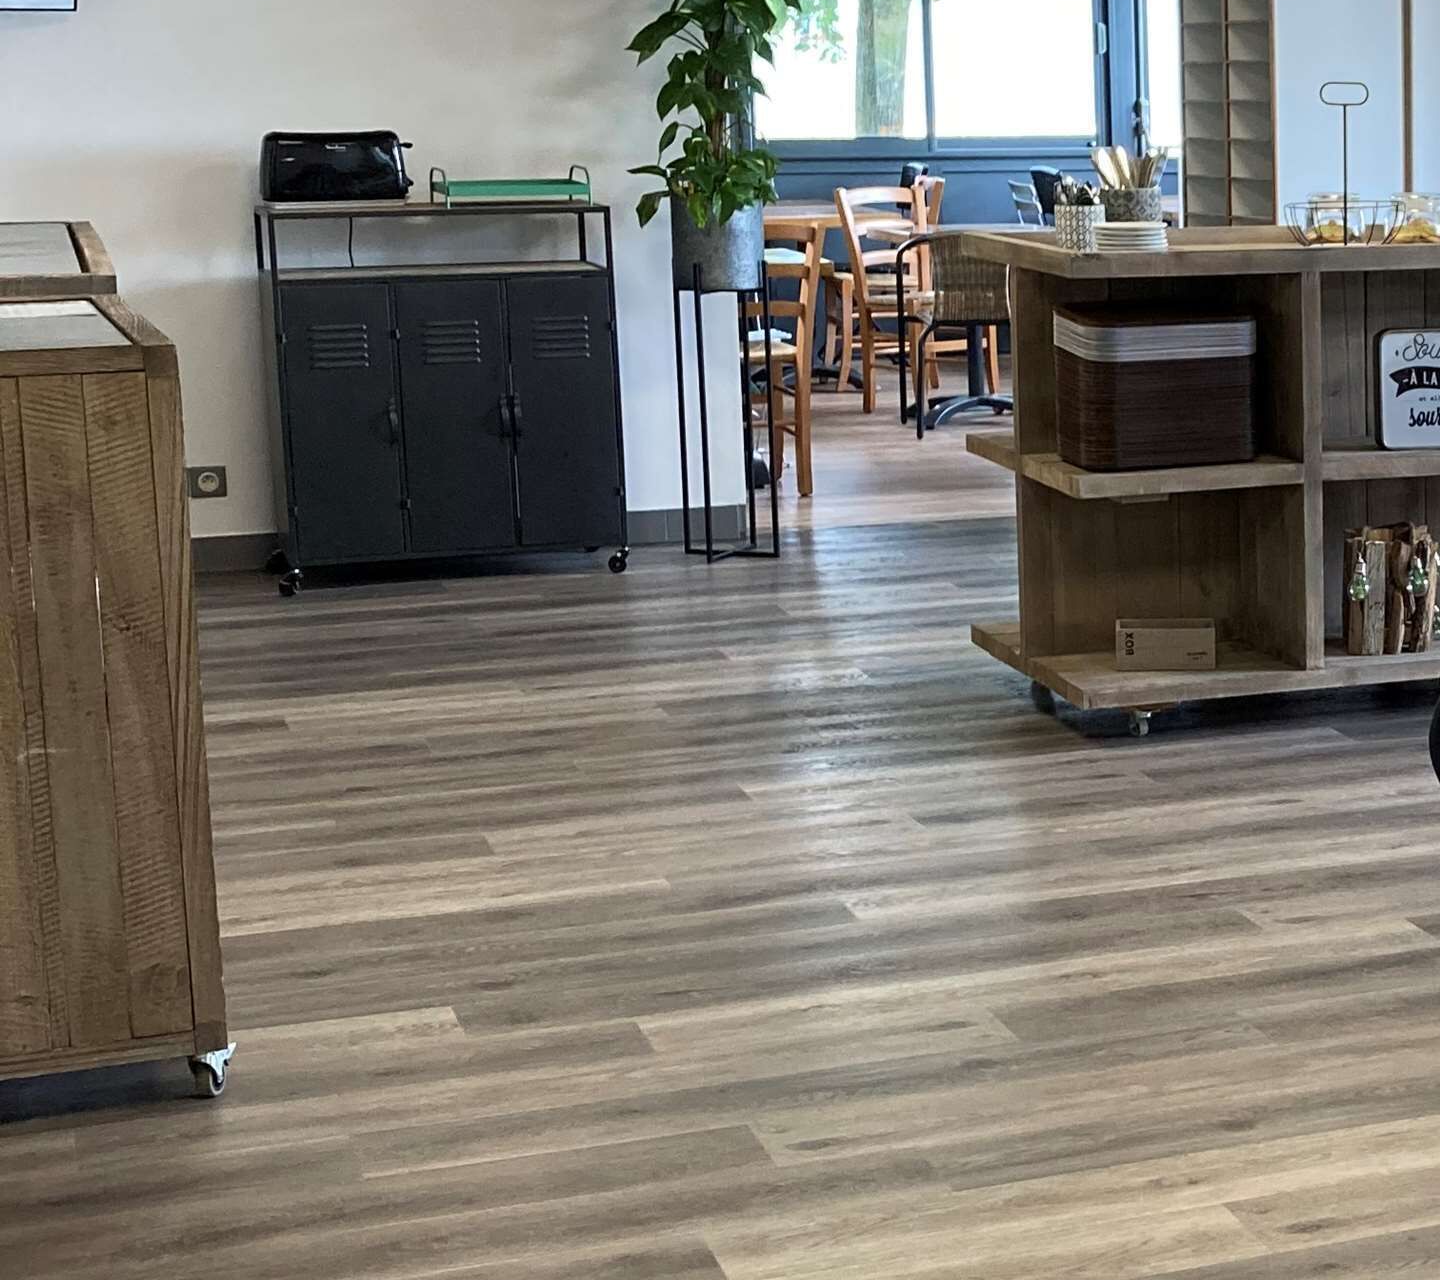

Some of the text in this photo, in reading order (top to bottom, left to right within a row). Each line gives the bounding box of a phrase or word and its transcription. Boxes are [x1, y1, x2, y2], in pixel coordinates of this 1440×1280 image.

[1410, 369, 1417, 385] À
[1423, 372, 1437, 385] LA
[1125, 632, 1134, 656] BOX
